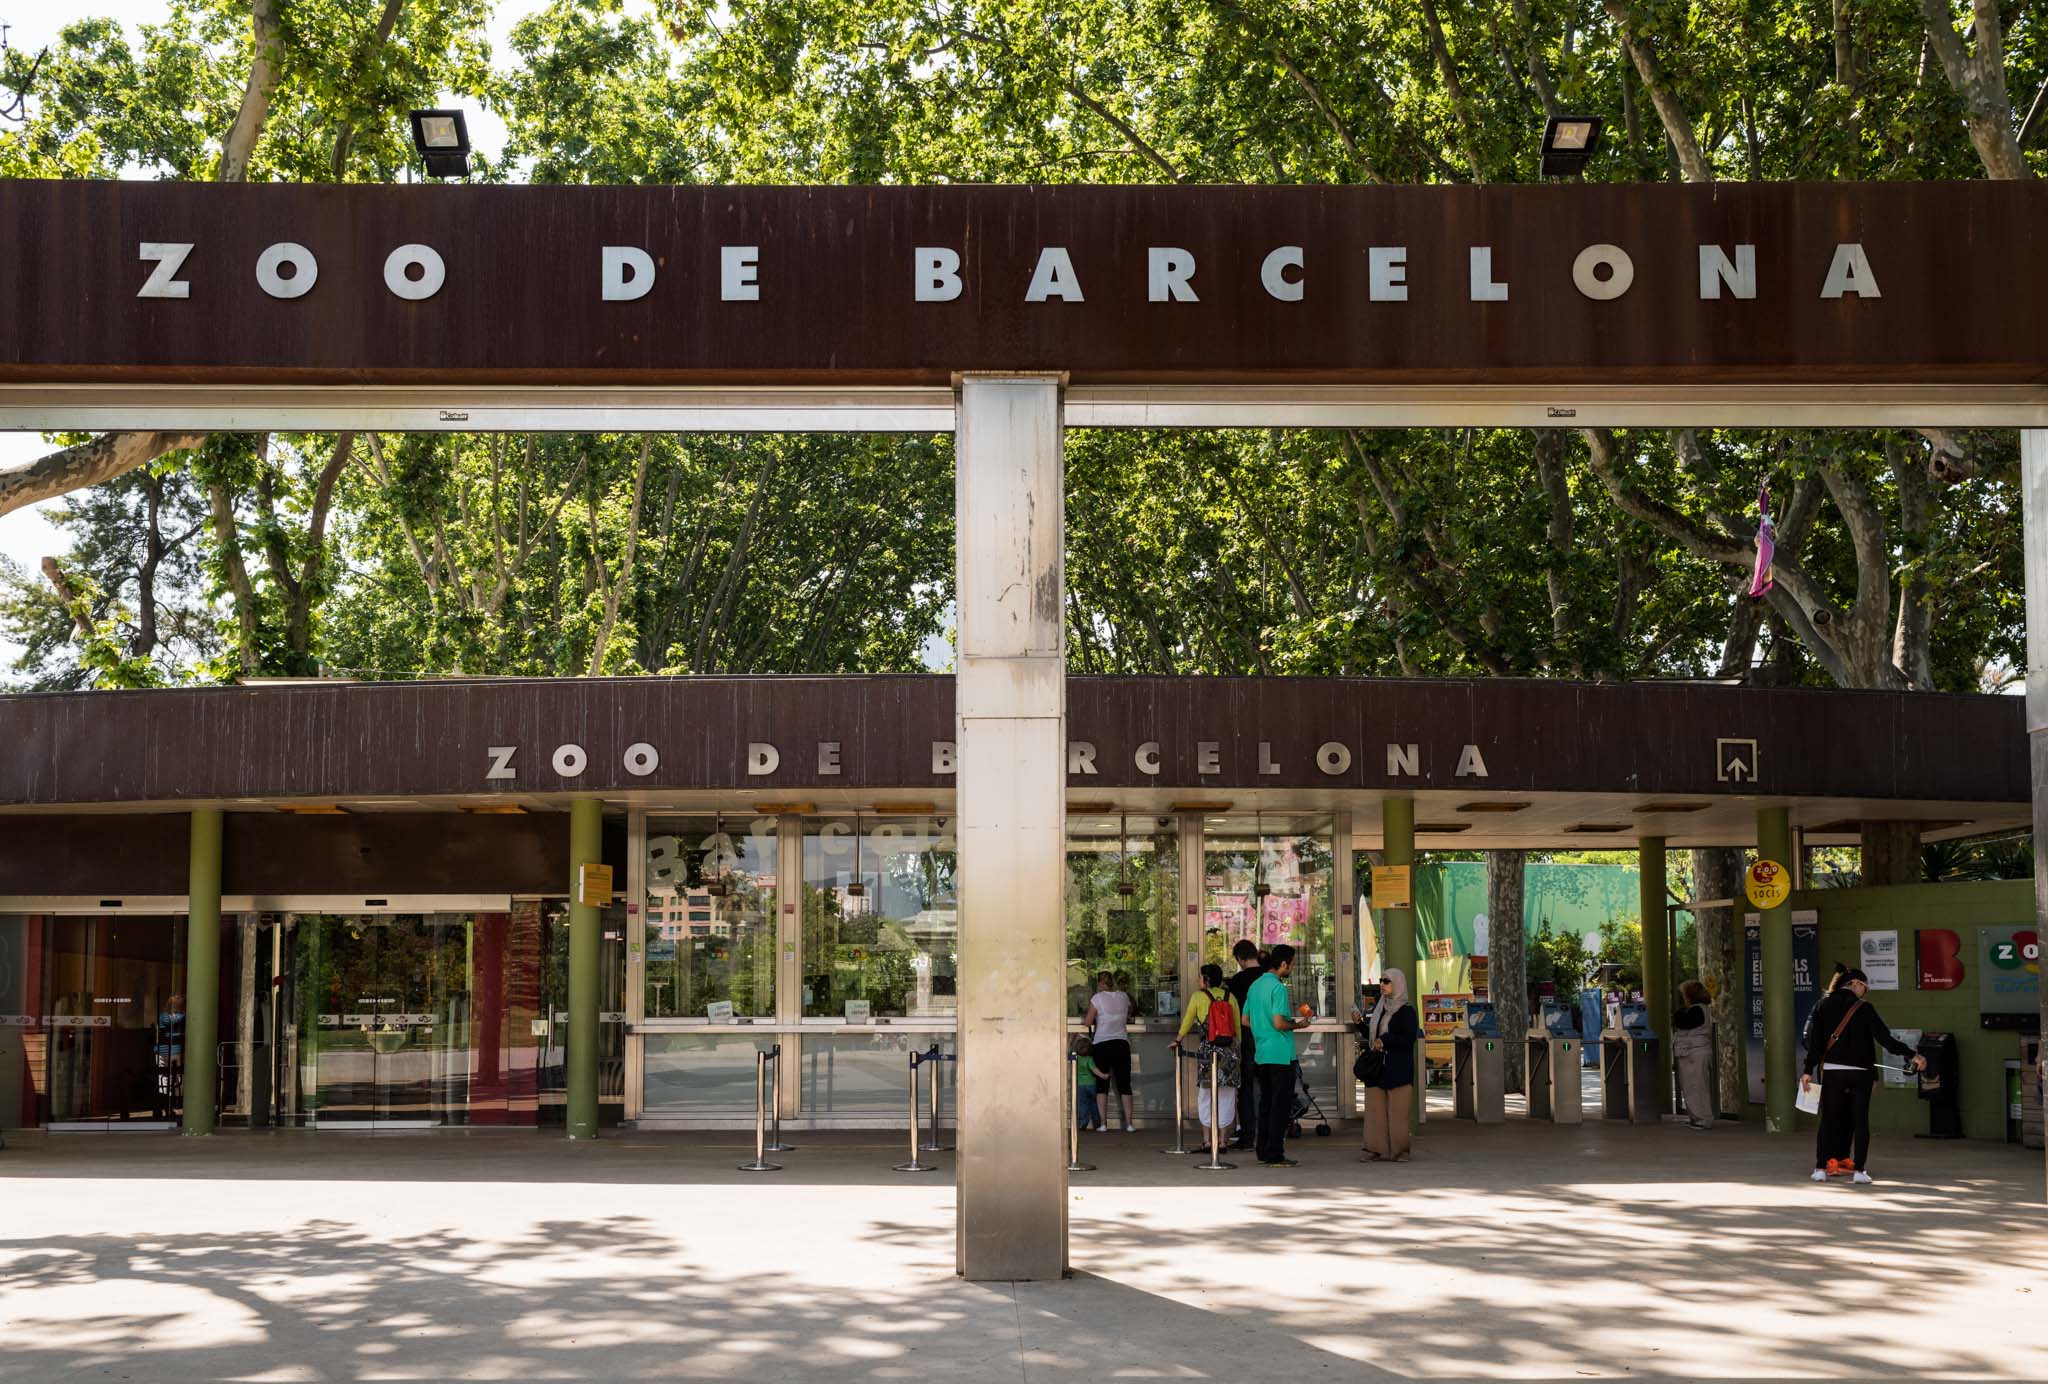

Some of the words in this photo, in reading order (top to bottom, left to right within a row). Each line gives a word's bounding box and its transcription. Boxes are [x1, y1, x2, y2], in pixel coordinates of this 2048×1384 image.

[137, 242, 446, 300] ZOO
[601, 246, 760, 302] DE
[914, 243, 1881, 303] BARCELONA
[485, 743, 660, 781] ZOO
[747, 742, 841, 776] DE
[932, 741, 1489, 777] BRCELONA
[1753, 887, 1781, 899] SOCIS
[1998, 943, 2039, 960] ZO
